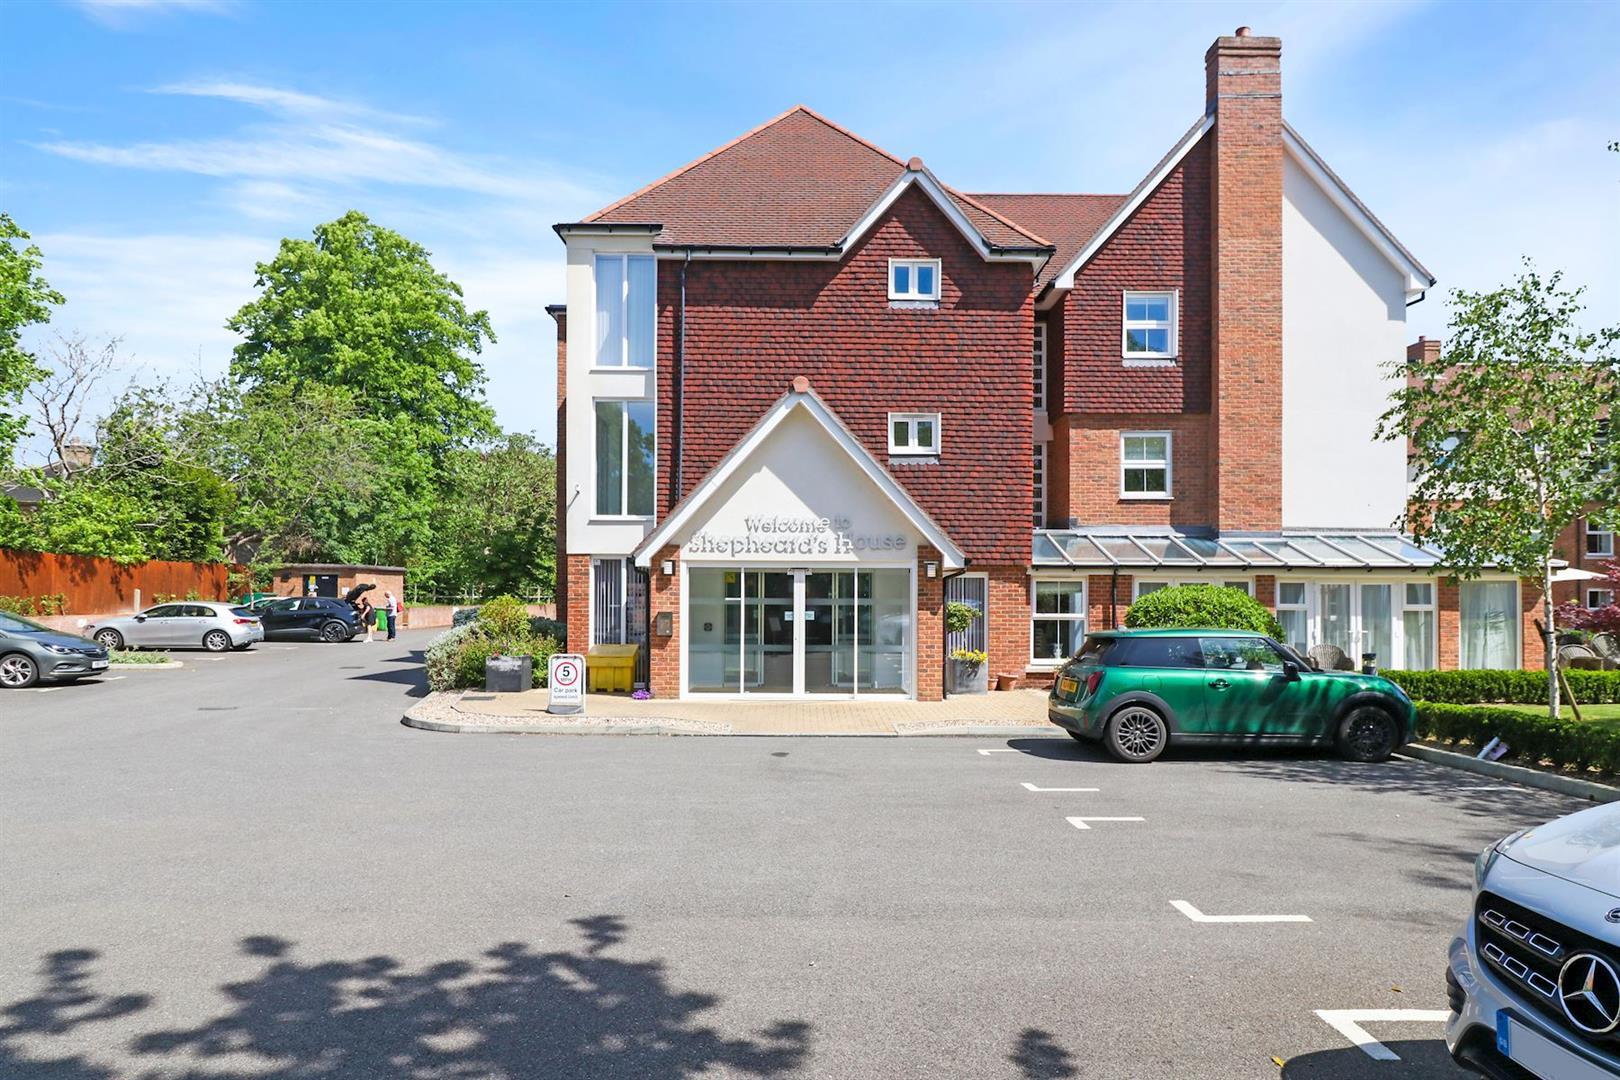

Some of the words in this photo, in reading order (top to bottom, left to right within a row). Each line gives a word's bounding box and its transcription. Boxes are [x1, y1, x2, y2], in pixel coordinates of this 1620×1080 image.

[744, 516, 830, 533] Welcome
[834, 516, 851, 529] to
[689, 532, 828, 557] Shepheard's
[834, 532, 906, 554] House
[562, 666, 570, 677] 5
